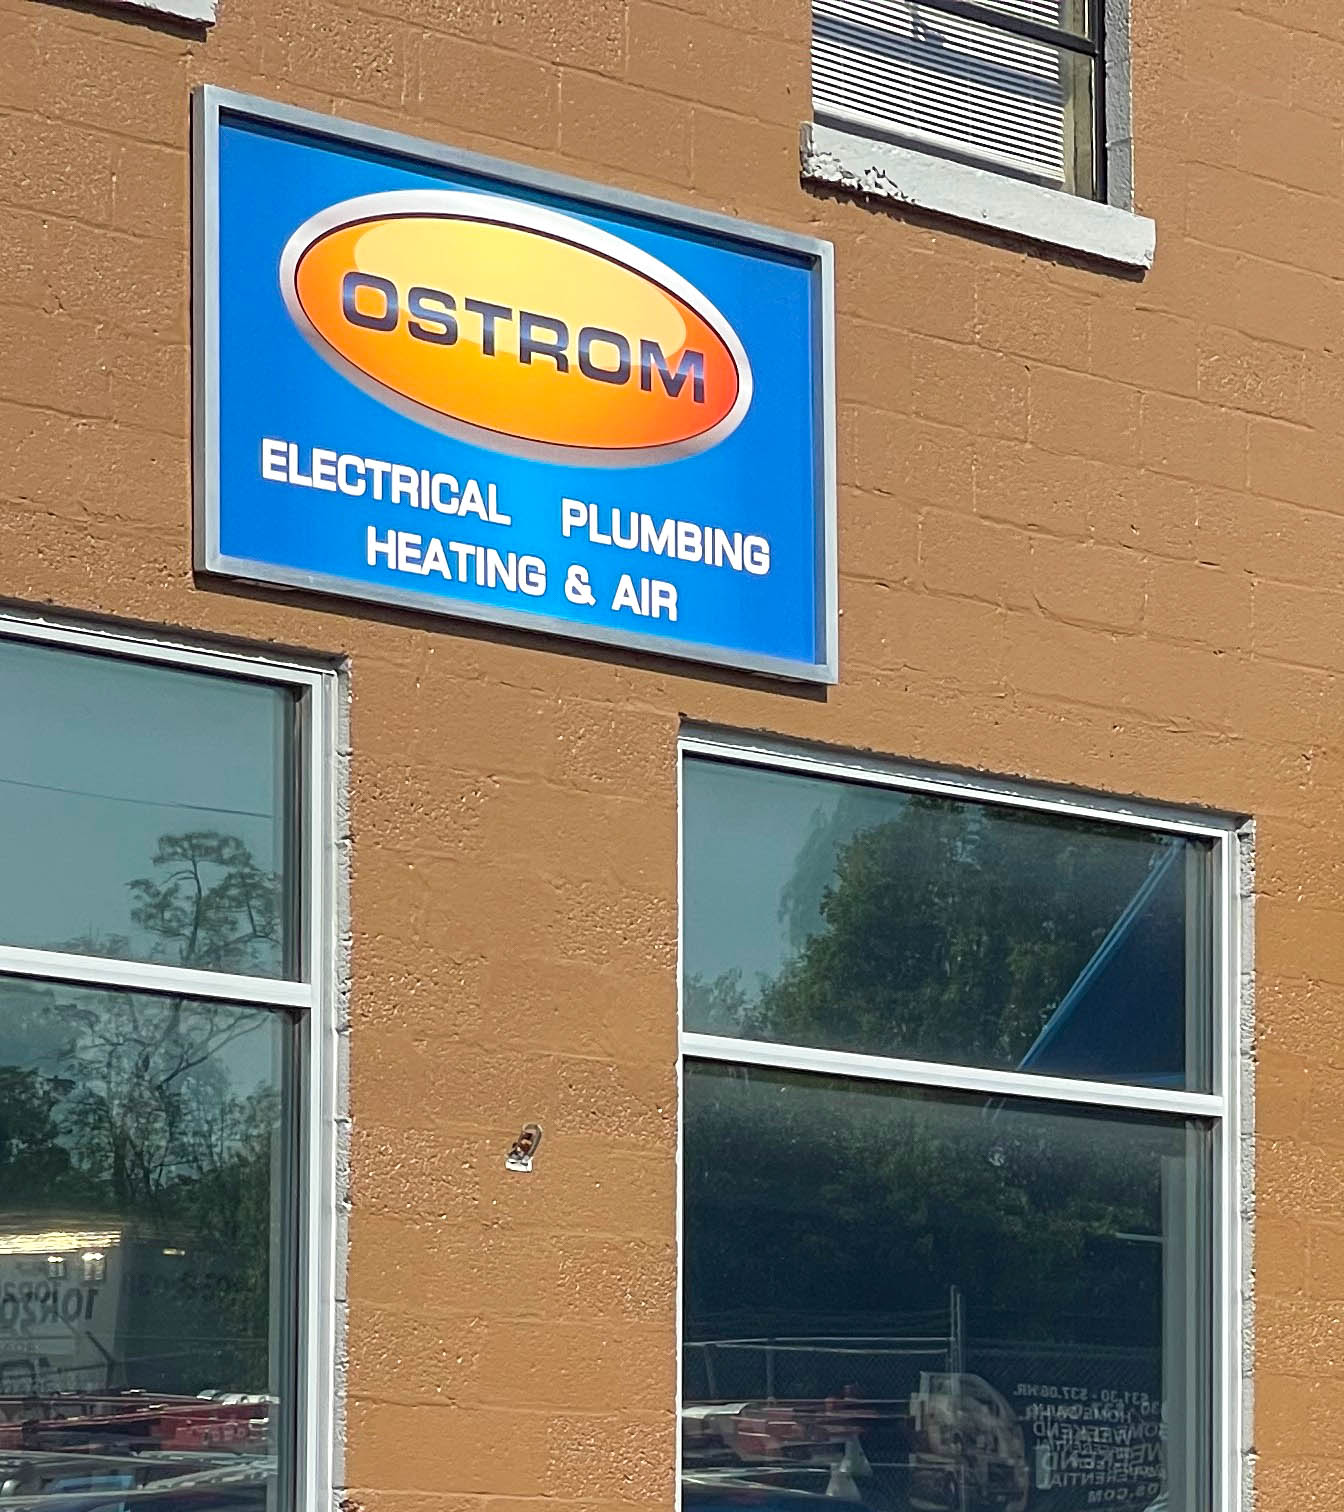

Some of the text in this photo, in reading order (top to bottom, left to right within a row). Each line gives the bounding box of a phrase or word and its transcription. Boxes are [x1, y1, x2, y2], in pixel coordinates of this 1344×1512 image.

[342, 271, 706, 404] OSTROM
[261, 438, 771, 576] ELECTRICAL PLUMBING
[366, 526, 678, 622] HEATING & AIR
